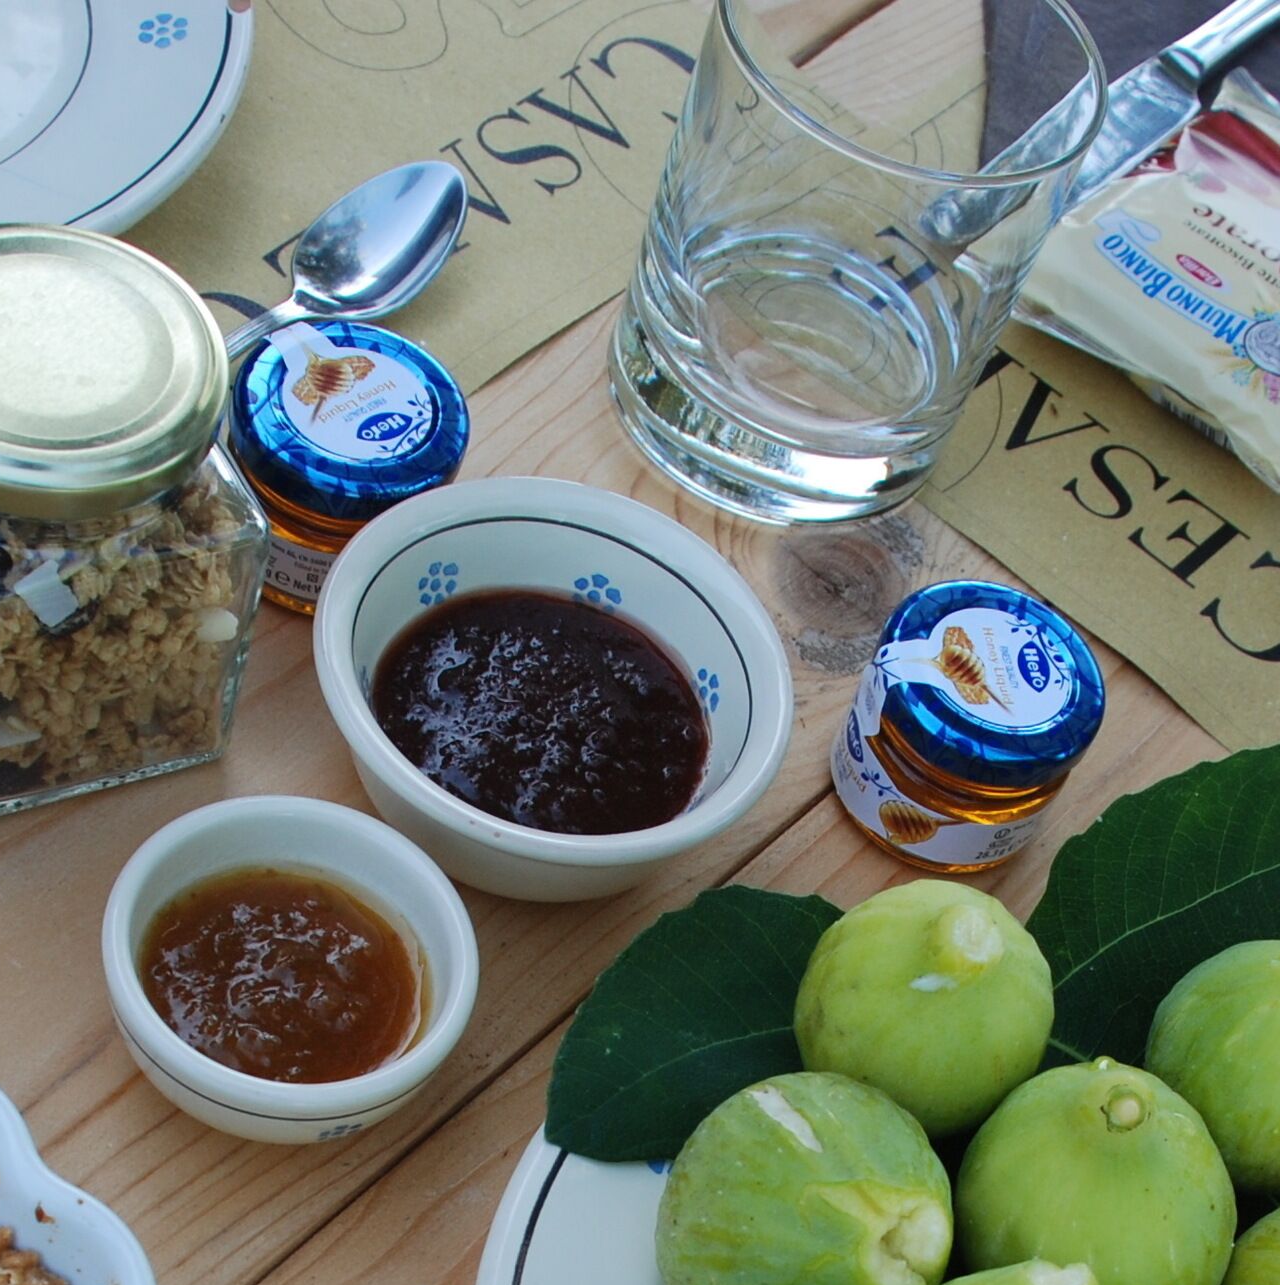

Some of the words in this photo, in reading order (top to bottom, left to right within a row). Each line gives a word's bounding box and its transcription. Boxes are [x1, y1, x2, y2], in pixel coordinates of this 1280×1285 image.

[1182, 218, 1254, 273] Biscottate
[1103, 234, 1170, 299] BIANCO
[1176, 255, 1222, 287] Barilla
[1165, 284, 1248, 346] MULINO
[357, 379, 397, 401] Honey
[319, 399, 359, 424] Liquid
[361, 414, 407, 440] Hero
[293, 579, 312, 593] Net
[313, 584, 323, 594] W
[980, 626, 1000, 663] Honey
[992, 666, 1014, 706] Liquid
[1022, 647, 1045, 689] Hero
